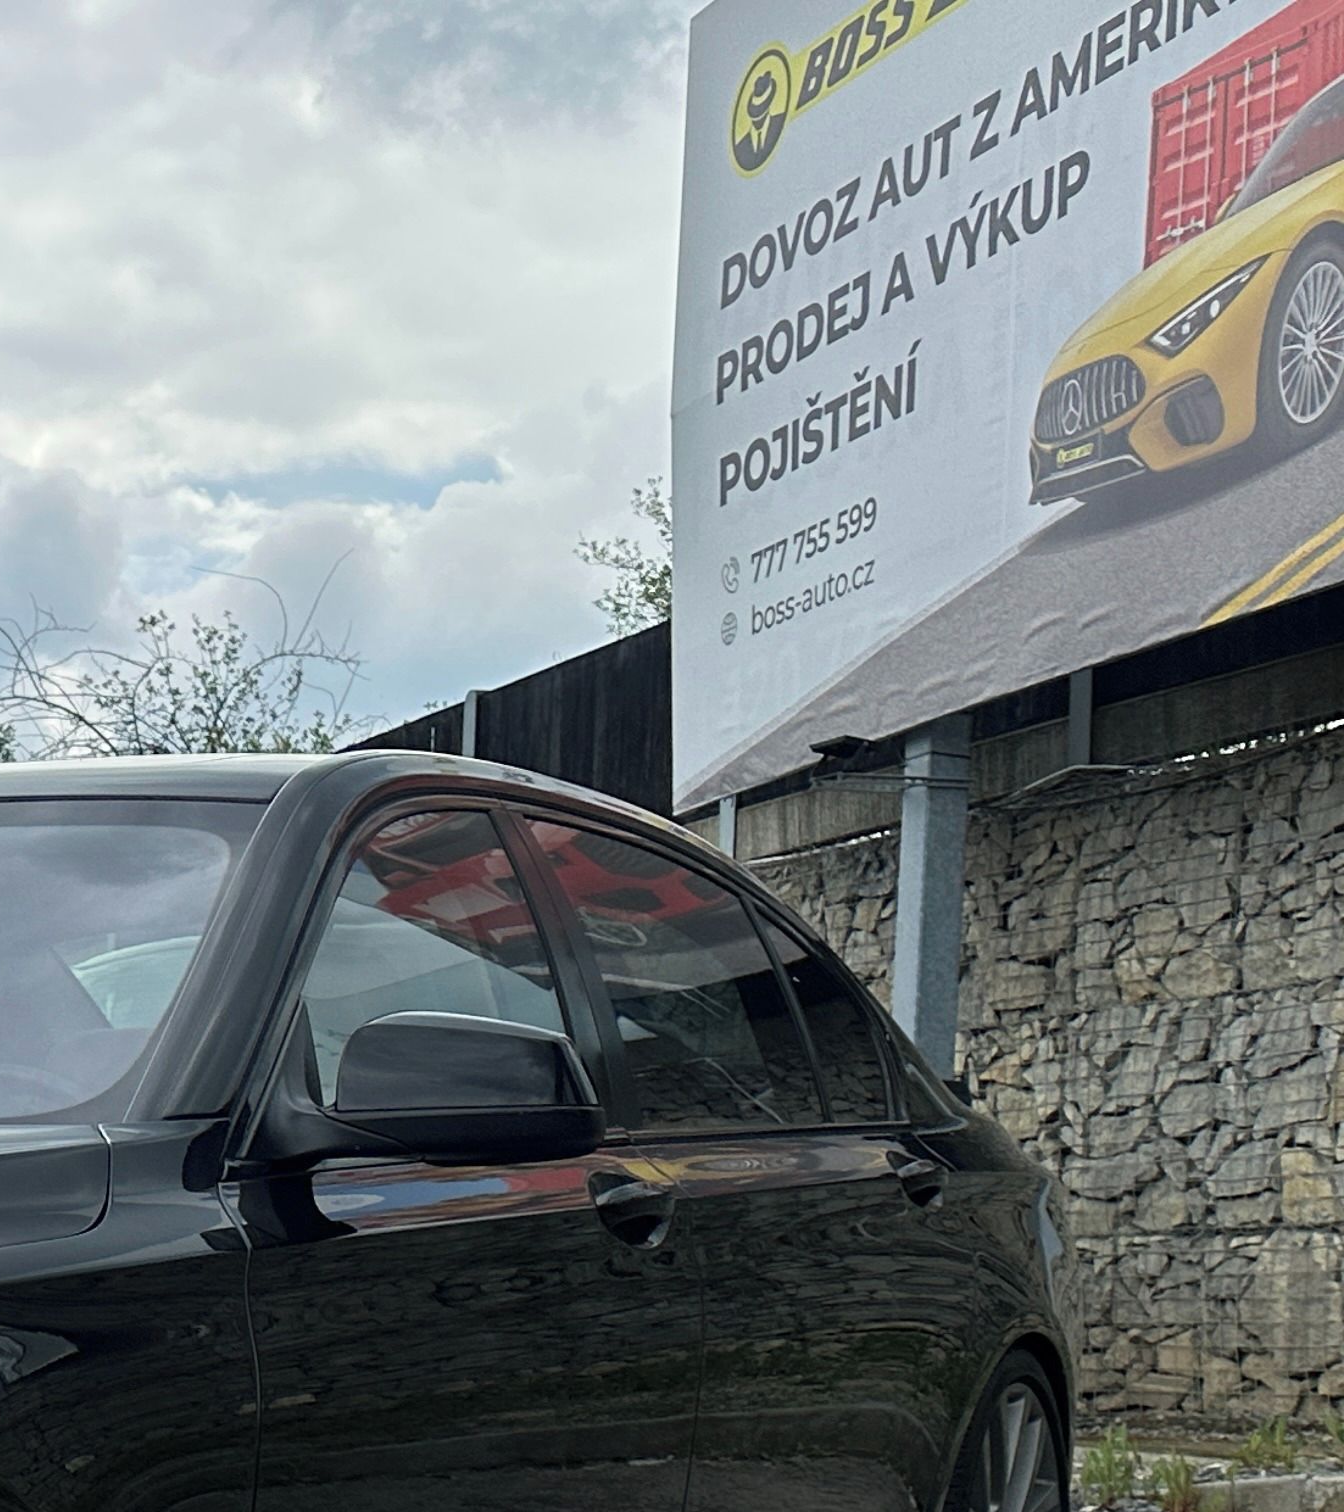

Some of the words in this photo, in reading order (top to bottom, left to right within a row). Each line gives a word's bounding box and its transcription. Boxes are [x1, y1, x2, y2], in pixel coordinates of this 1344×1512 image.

[796, 0, 914, 111] BOSS
[720, 176, 861, 310] DOVOZ
[867, 114, 961, 222] AUT
[970, 89, 1001, 161] Z
[1010, 0, 1237, 137] AMERIK
[716, 271, 871, 406] PRODEJ
[880, 252, 915, 315] A
[925, 150, 1090, 286] VÝKUP
[719, 338, 922, 507] POJIŠTĚNÍ
[751, 538, 788, 583] 777
[793, 518, 830, 564] 755
[835, 497, 877, 544] 599
[752, 560, 875, 635] boss-auto.cz
